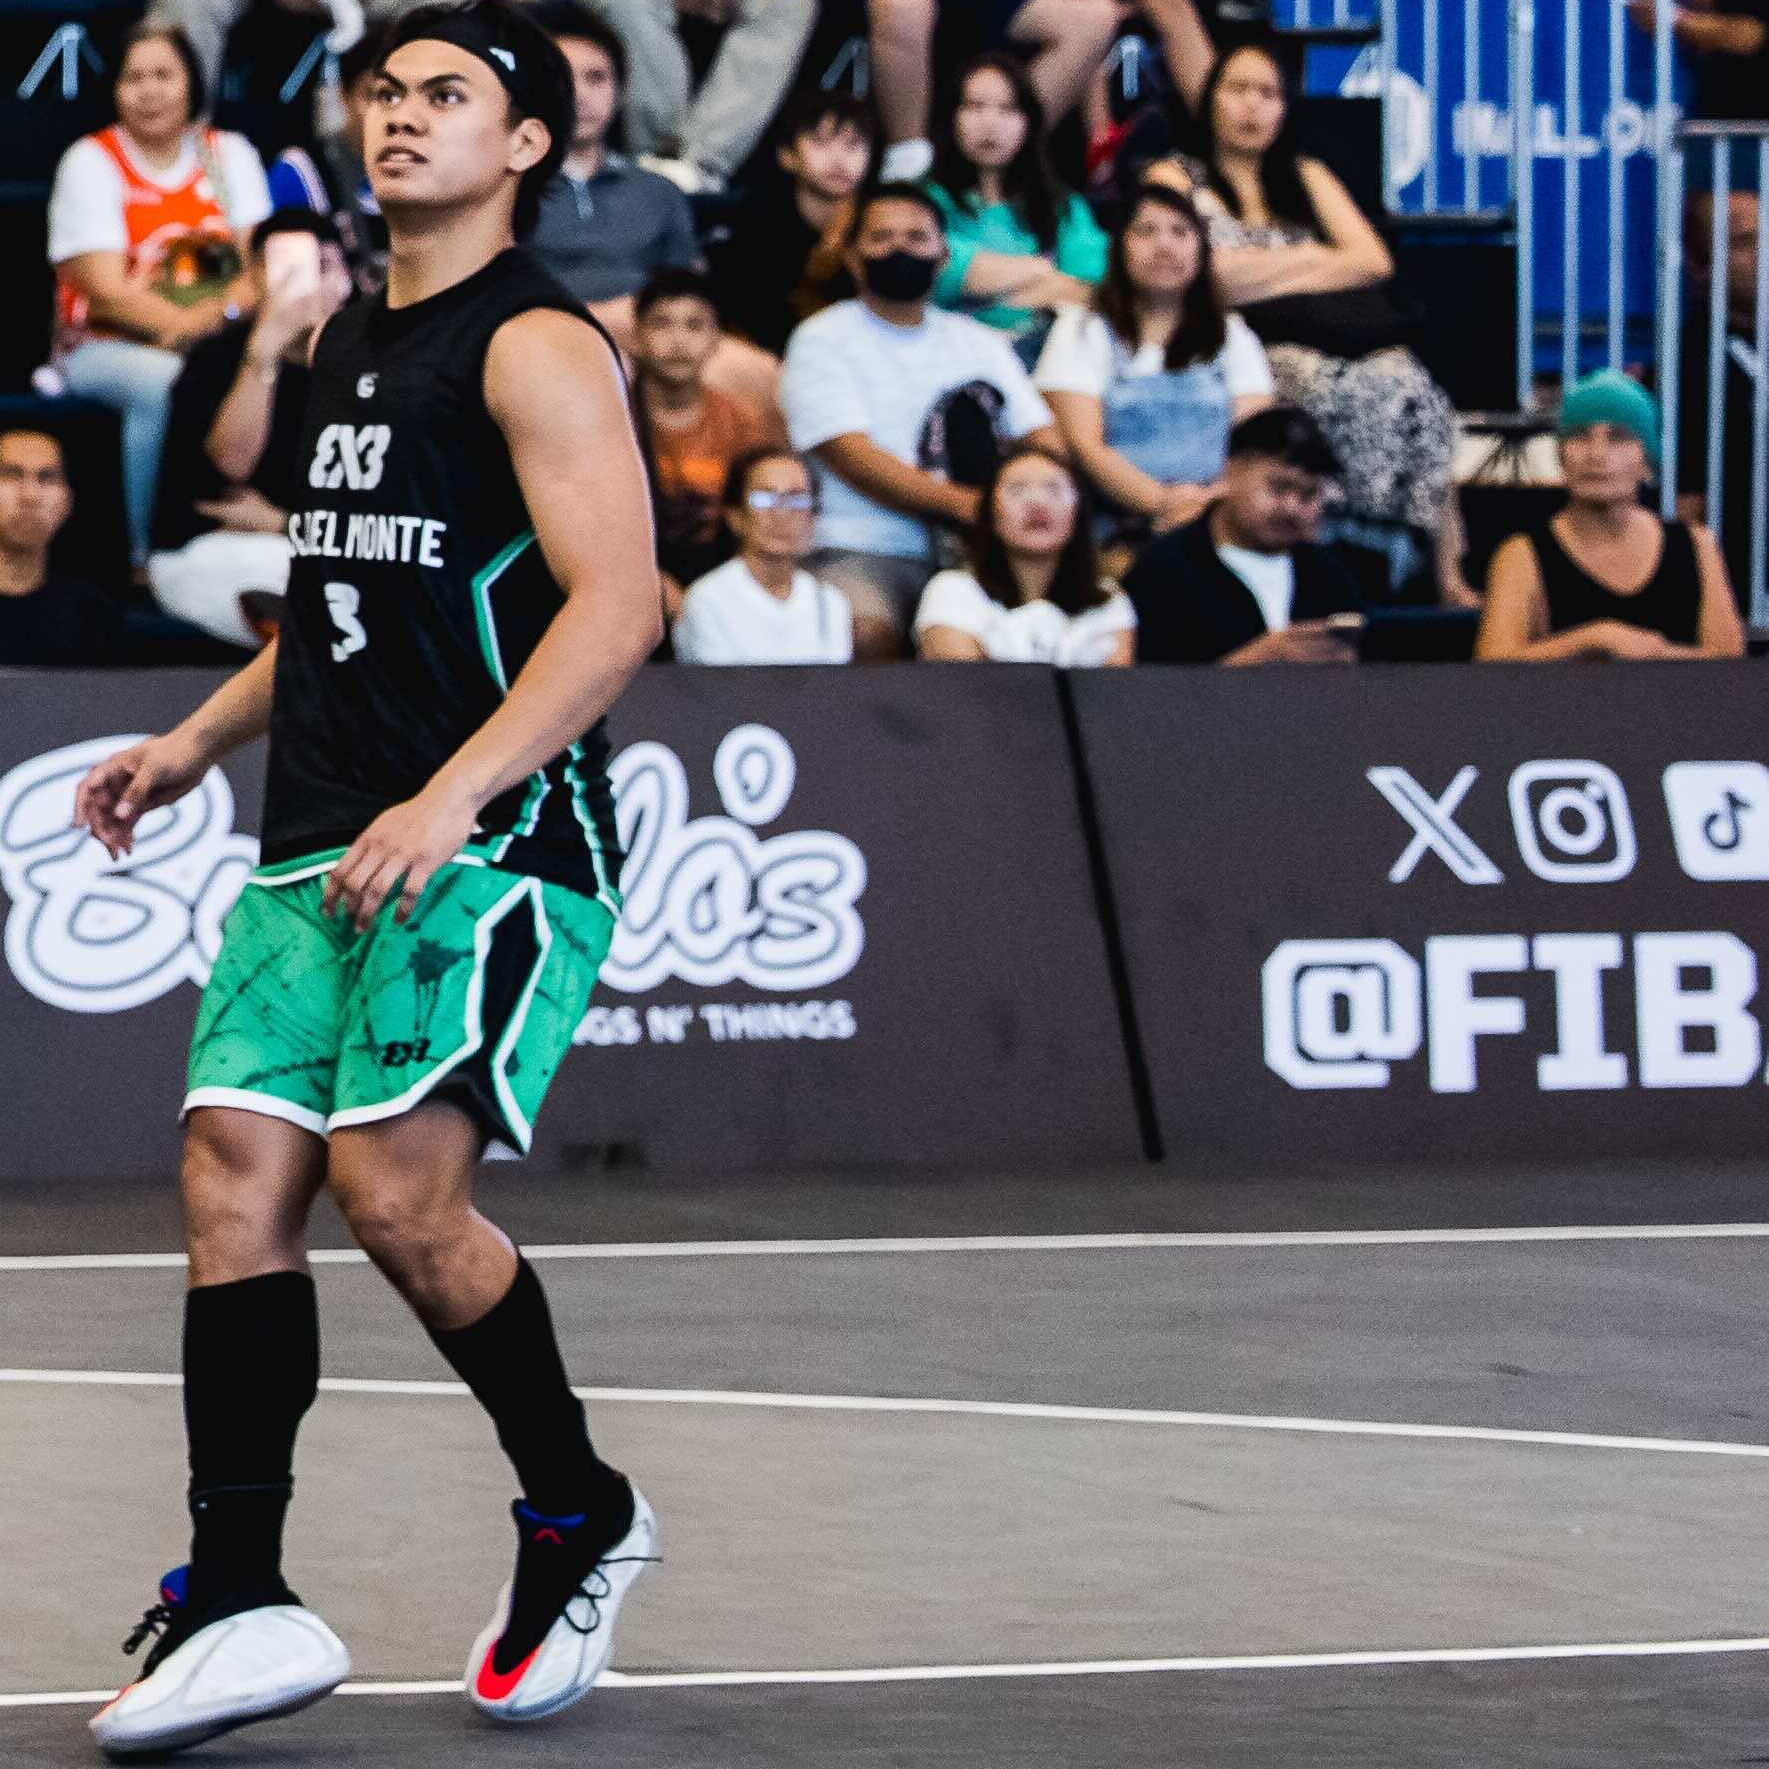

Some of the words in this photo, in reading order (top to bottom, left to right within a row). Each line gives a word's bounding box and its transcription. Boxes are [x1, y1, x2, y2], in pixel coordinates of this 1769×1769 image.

[343, 513, 447, 568] MONTE
[699, 999, 858, 1042] THINGS
[1261, 931, 1769, 1094] @FIB
